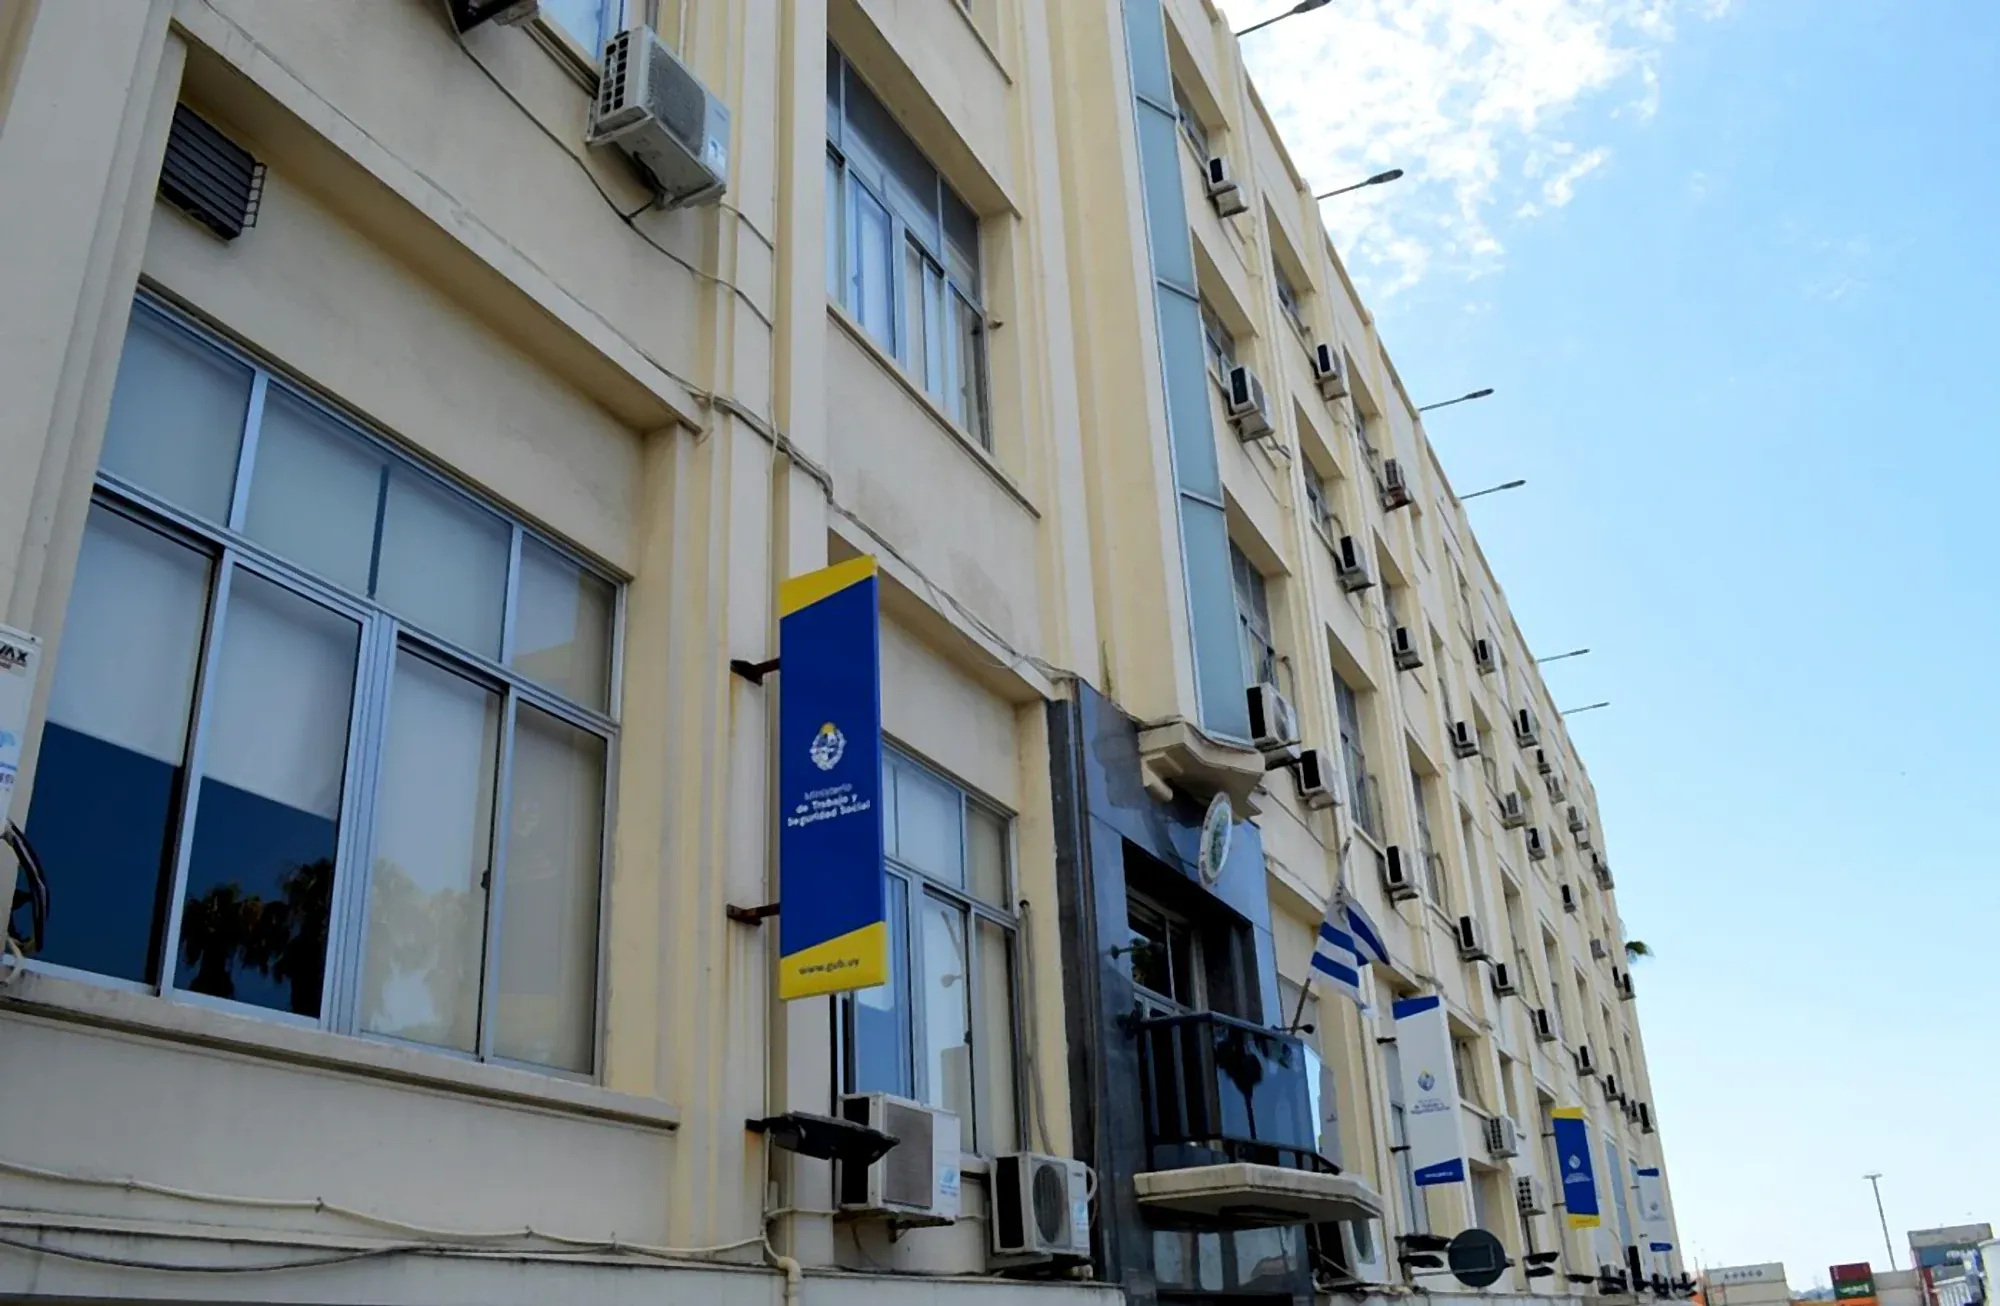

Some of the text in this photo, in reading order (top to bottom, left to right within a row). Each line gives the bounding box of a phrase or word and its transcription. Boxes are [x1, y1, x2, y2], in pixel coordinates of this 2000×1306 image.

[804, 783, 852, 800] Ministerio
[787, 800, 871, 827] Seguridad Social
[795, 804, 809, 814] de
[812, 795, 849, 810] Trabajo
